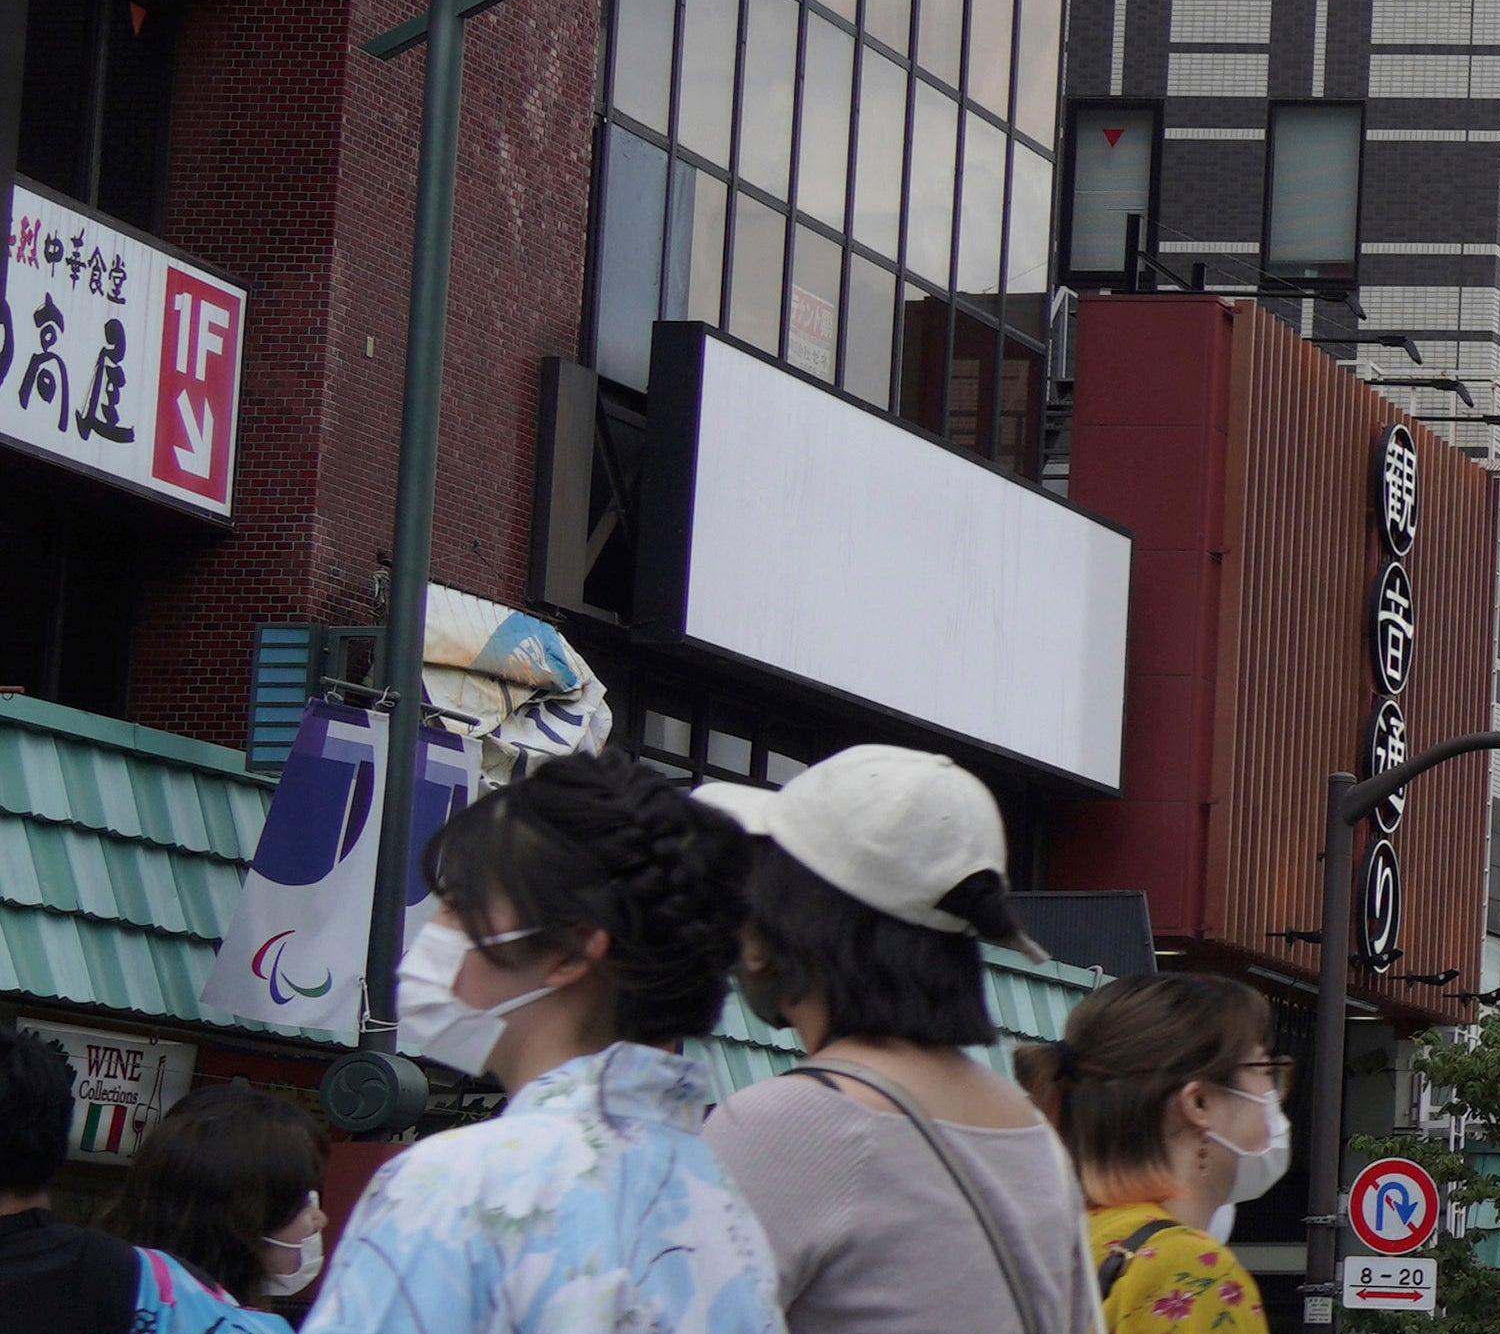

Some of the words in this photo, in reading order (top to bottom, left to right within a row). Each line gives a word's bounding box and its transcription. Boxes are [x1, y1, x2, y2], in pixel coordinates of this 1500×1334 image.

[0, 291, 135, 444] 高屋
[173, 291, 231, 382] 1F
[78, 1079, 139, 1105] Collections
[86, 1044, 145, 1082] WINE
